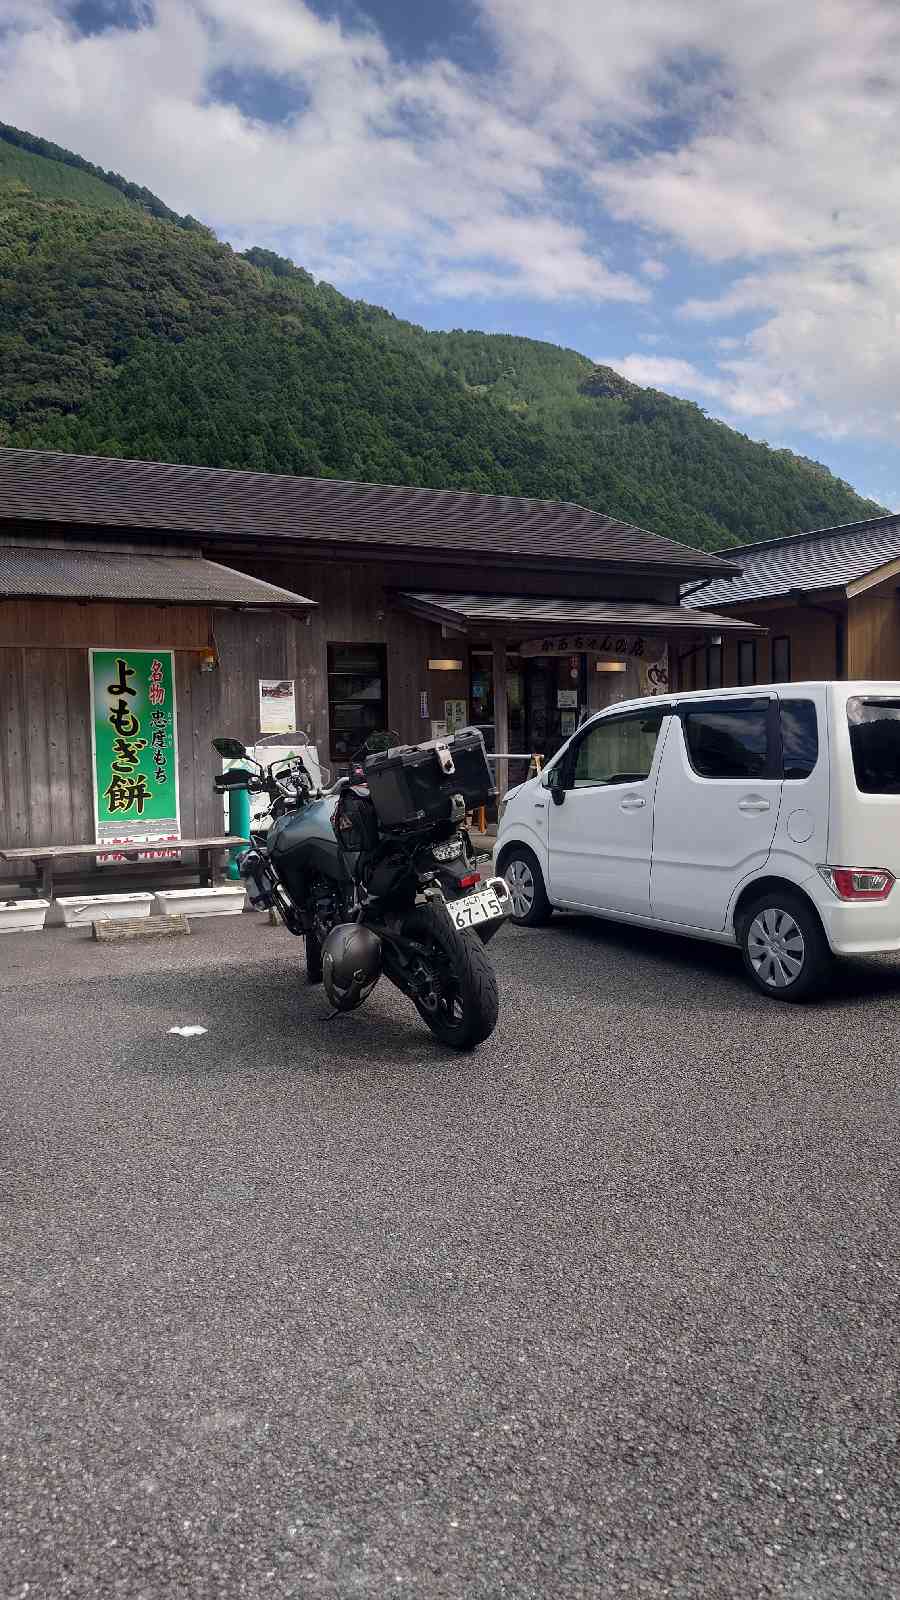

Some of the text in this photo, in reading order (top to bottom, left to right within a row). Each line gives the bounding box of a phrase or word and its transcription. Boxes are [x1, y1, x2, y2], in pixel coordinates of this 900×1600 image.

[104, 658, 152, 815] よもぎ餅
[149, 660, 169, 784] 名物 忠度もち
[456, 900, 500, 928] 67-15
